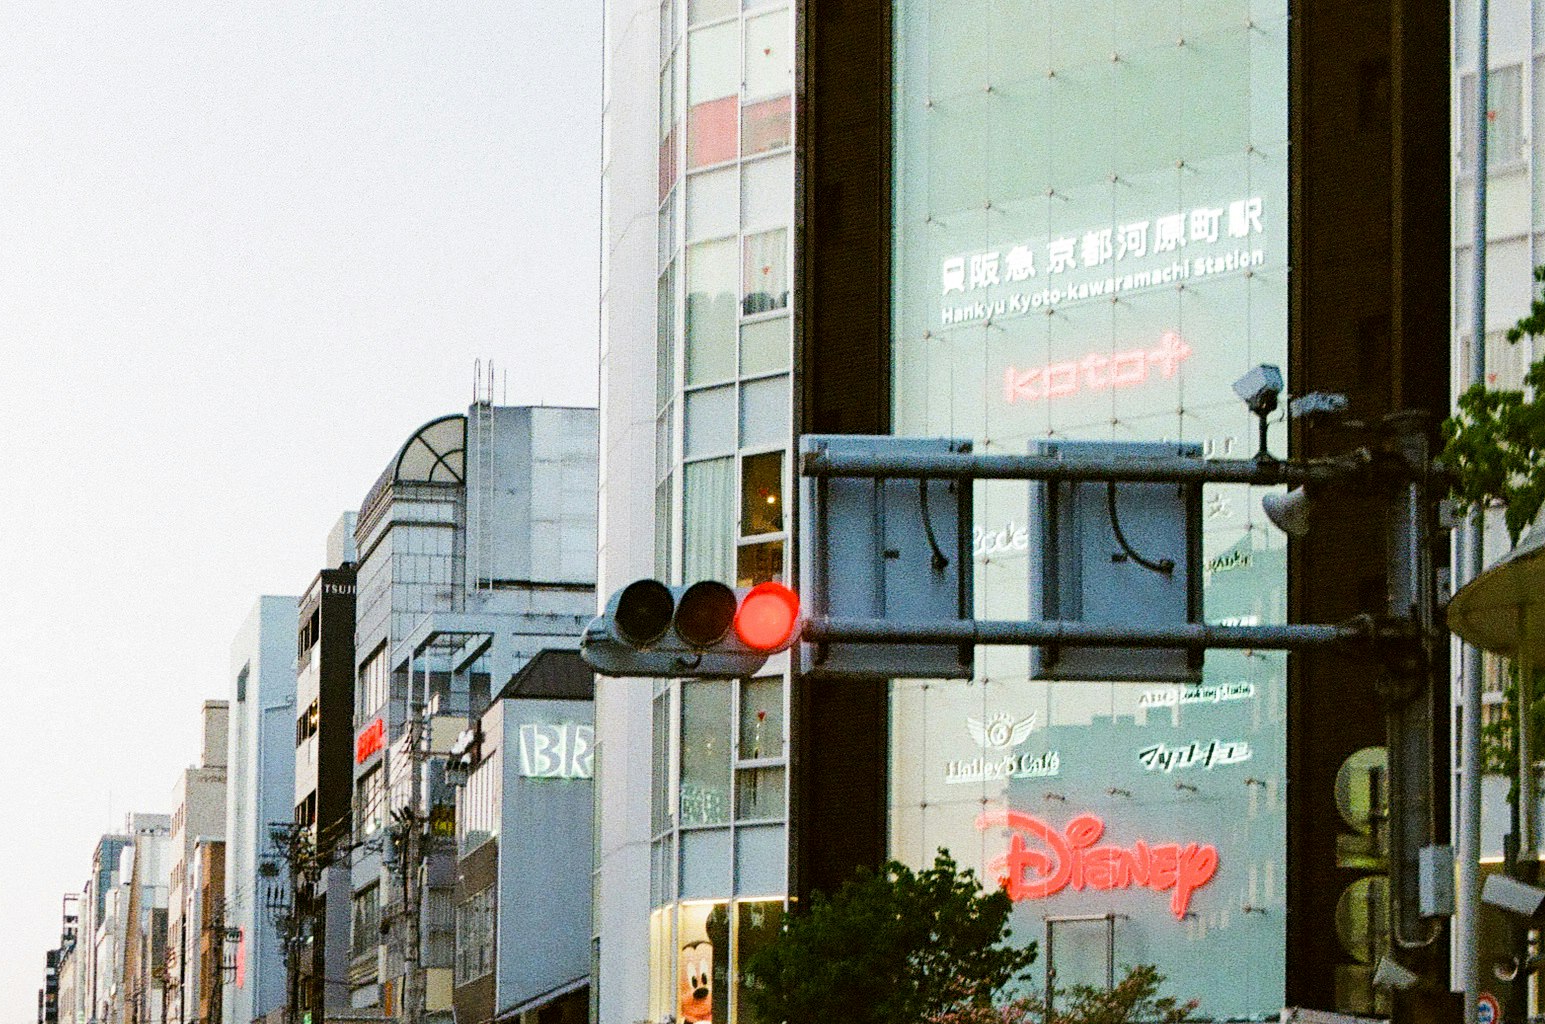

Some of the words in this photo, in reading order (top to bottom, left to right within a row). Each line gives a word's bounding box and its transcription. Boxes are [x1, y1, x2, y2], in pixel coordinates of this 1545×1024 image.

[941, 300, 1005, 324] Hankyu
[1193, 248, 1264, 276] Station
[970, 244, 1036, 291] 阪急
[1046, 196, 1264, 274] 京都河原町駅
[974, 811, 1219, 921] Disney
